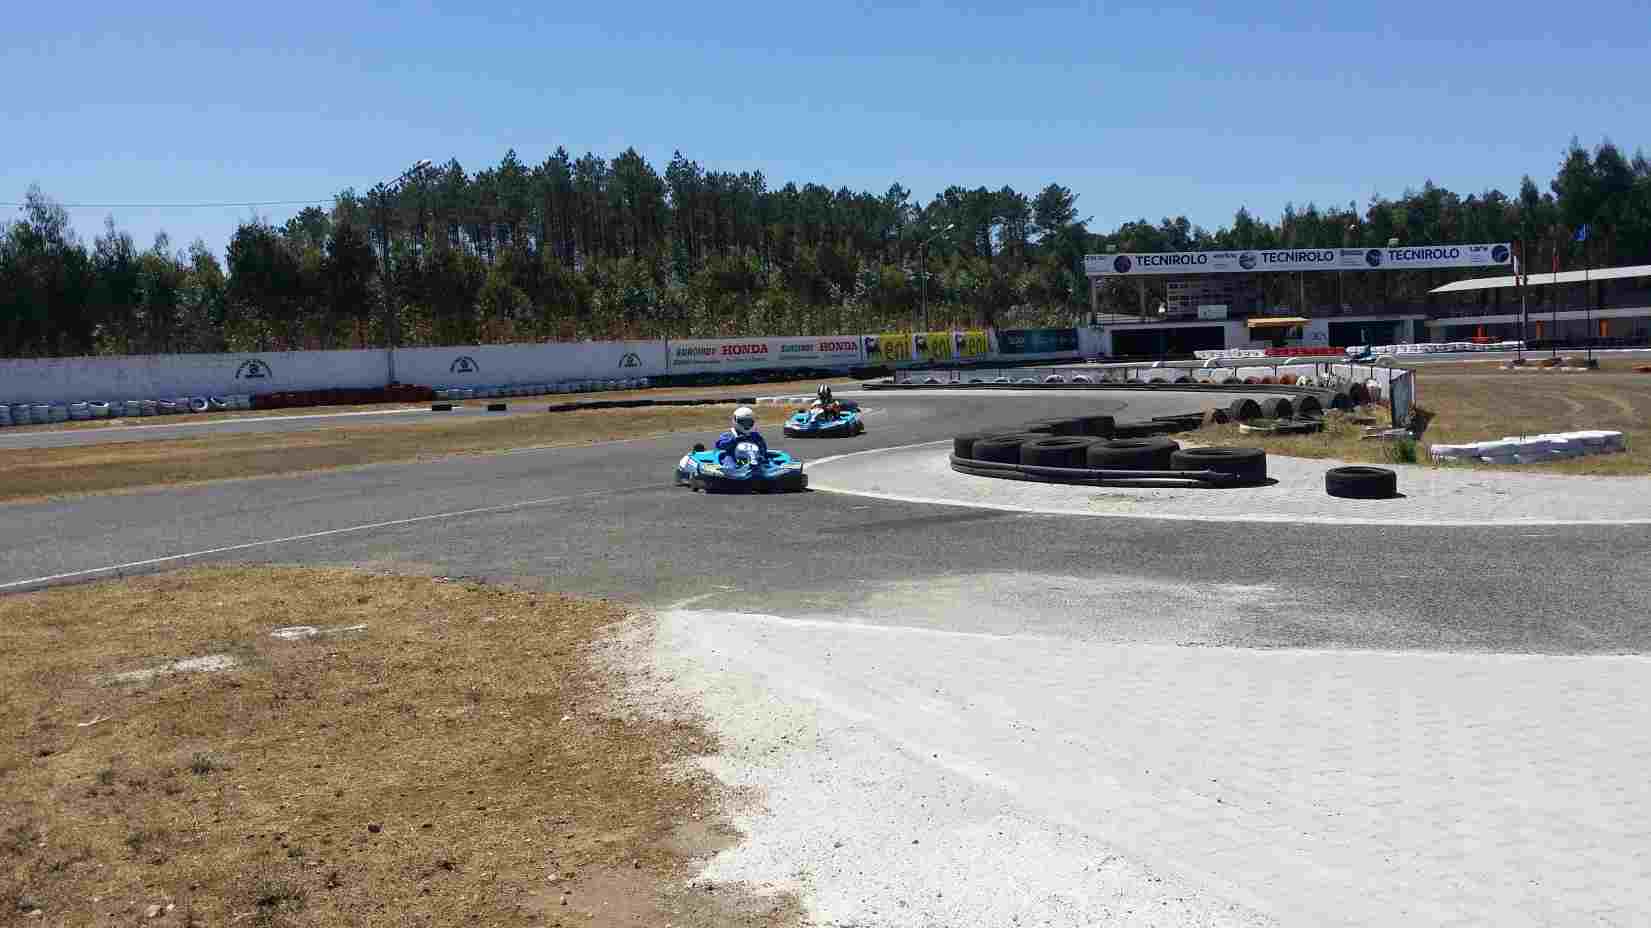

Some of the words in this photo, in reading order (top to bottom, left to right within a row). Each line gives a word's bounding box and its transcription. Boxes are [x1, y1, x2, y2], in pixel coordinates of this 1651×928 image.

[1135, 254, 1208, 265] TECNIROLO
[1262, 251, 1334, 263] TECNIROLO
[1388, 248, 1460, 261] TECNIROLO
[721, 344, 769, 355] HONDA
[819, 341, 858, 352] HONDA
